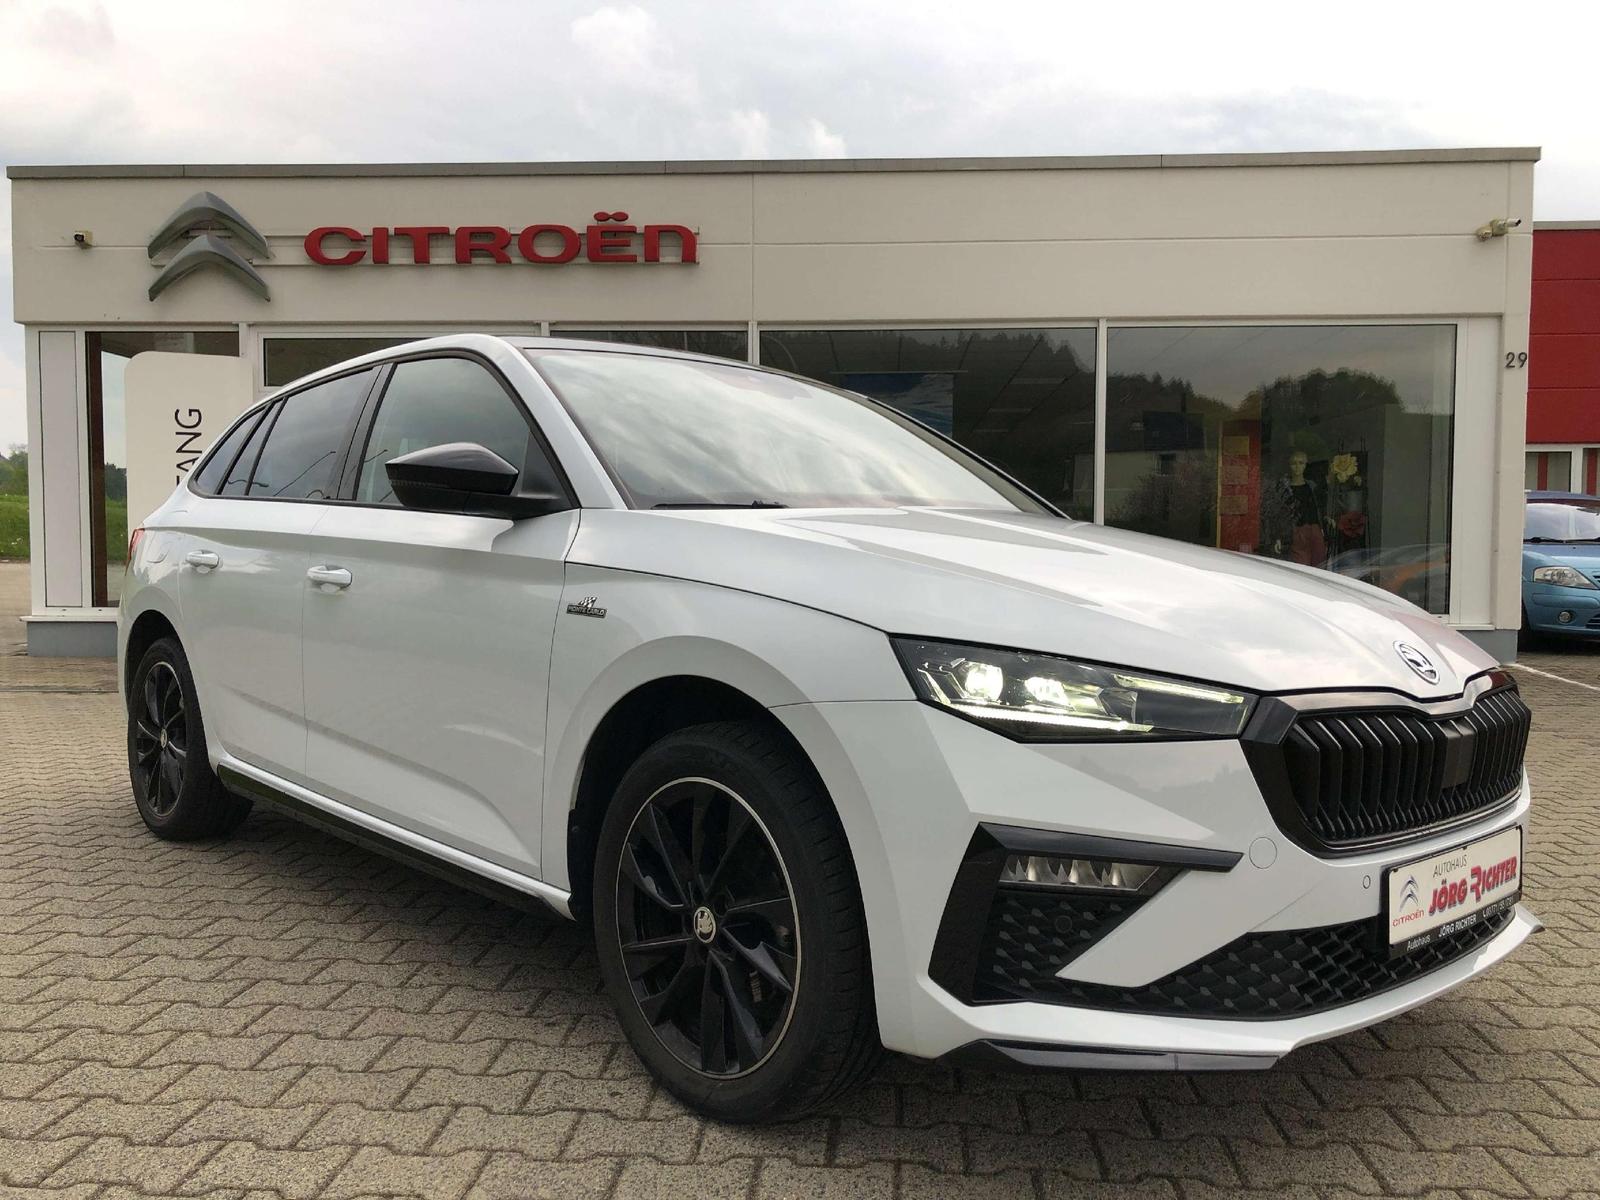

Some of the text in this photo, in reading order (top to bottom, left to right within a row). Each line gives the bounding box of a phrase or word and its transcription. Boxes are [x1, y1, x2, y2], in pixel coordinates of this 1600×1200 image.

[1505, 351, 1528, 369] 29
[174, 408, 203, 487] ANG
[586, 608, 605, 616] CARLO
[1432, 854, 1468, 878] AUTOHAUS
[1428, 878, 1468, 916] JÖRG
[1470, 856, 1518, 903] RICHTER
[1455, 914, 1477, 931] RICHTER
